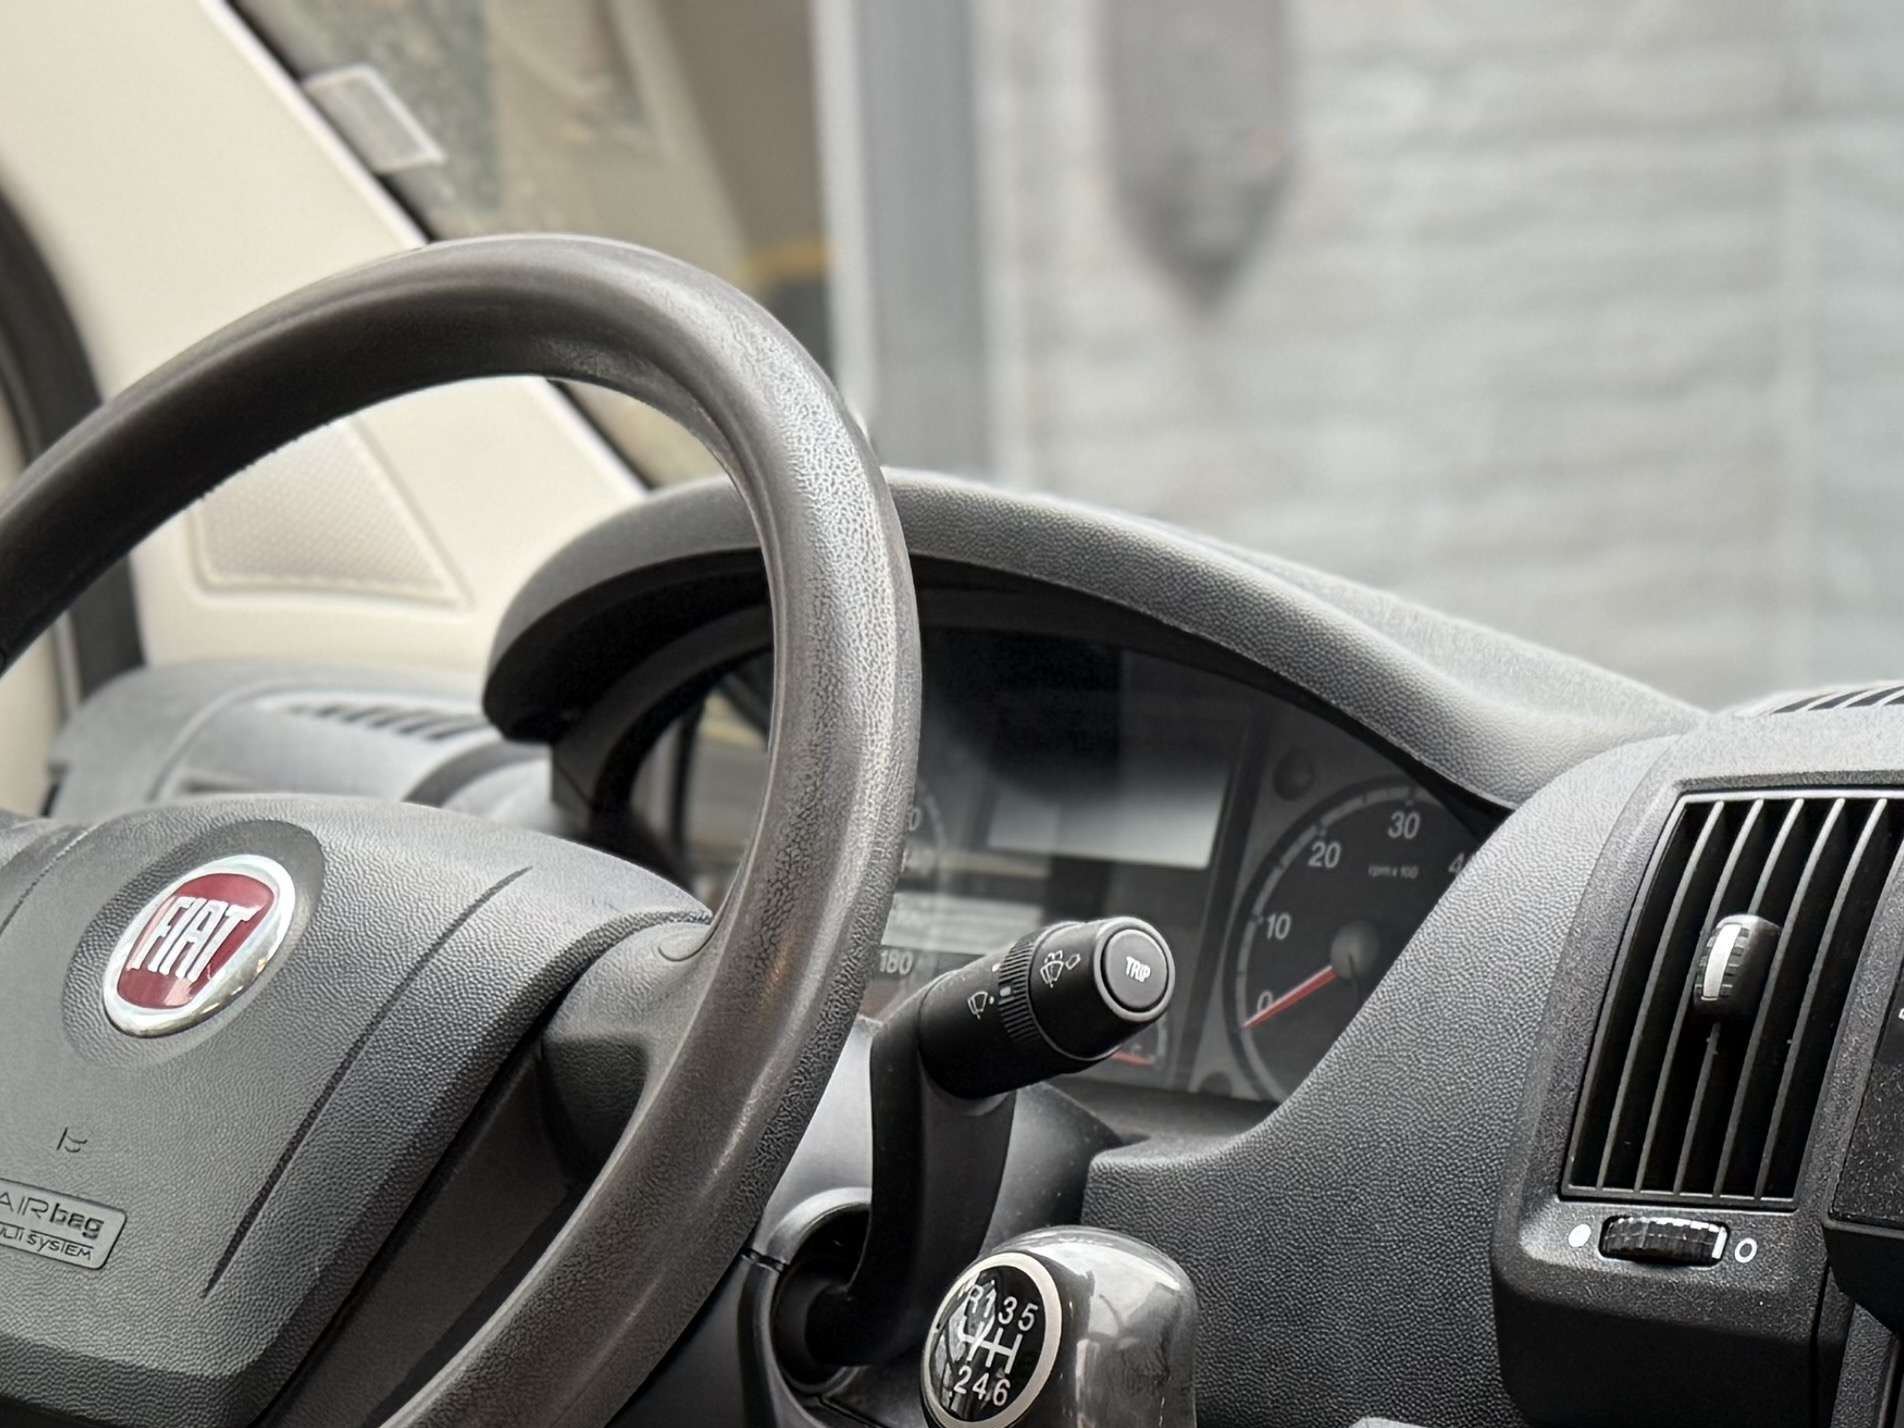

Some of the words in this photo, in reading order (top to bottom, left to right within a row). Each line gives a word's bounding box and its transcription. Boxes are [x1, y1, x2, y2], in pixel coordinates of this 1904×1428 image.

[1387, 811, 1421, 840] 30
[1307, 841, 1342, 869] 20
[125, 895, 265, 983] FIAT
[1264, 912, 1292, 941] 10
[1126, 955, 1151, 983] TRIP
[998, 1296, 1019, 1325] 3
[1018, 1302, 1039, 1332] 5
[953, 1365, 973, 1395] 2
[972, 1372, 990, 1401] 4
[992, 1377, 1012, 1407] 6
